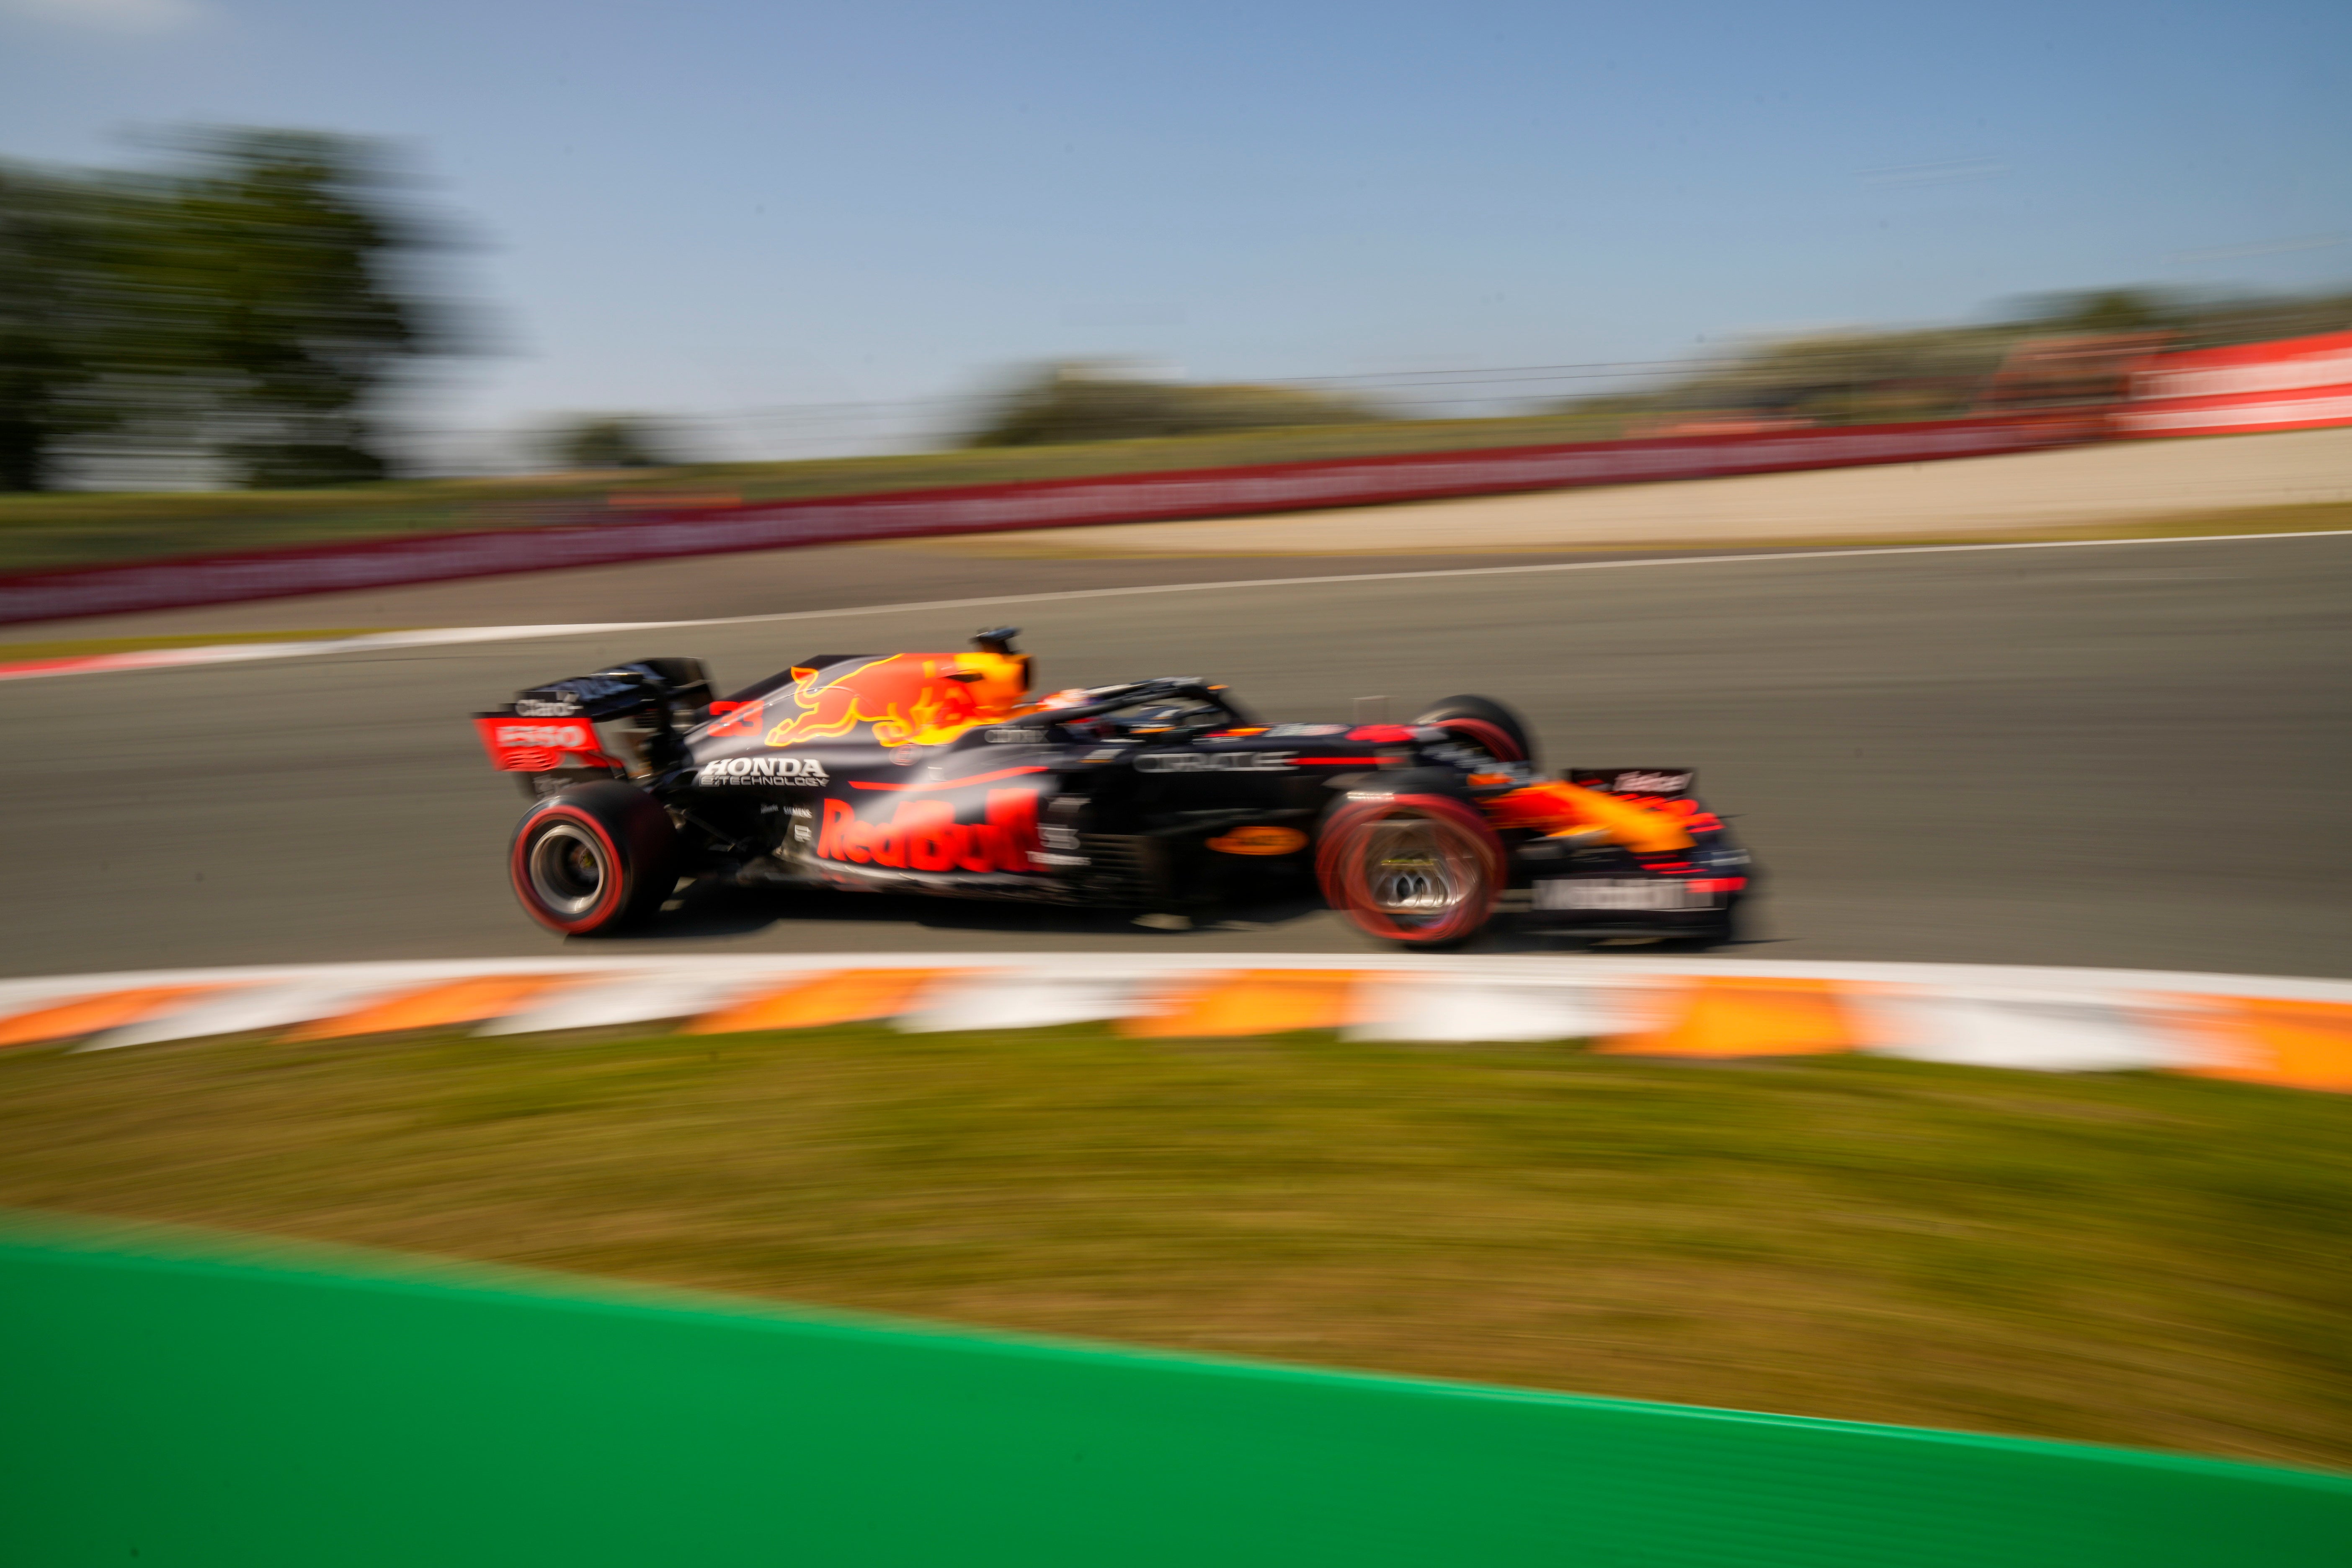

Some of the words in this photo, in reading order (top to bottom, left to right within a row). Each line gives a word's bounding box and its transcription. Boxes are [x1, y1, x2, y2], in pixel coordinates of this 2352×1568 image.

[707, 700, 764, 737] 33
[701, 757, 830, 778] HONDA
[783, 806, 812, 819] SIEMENS
